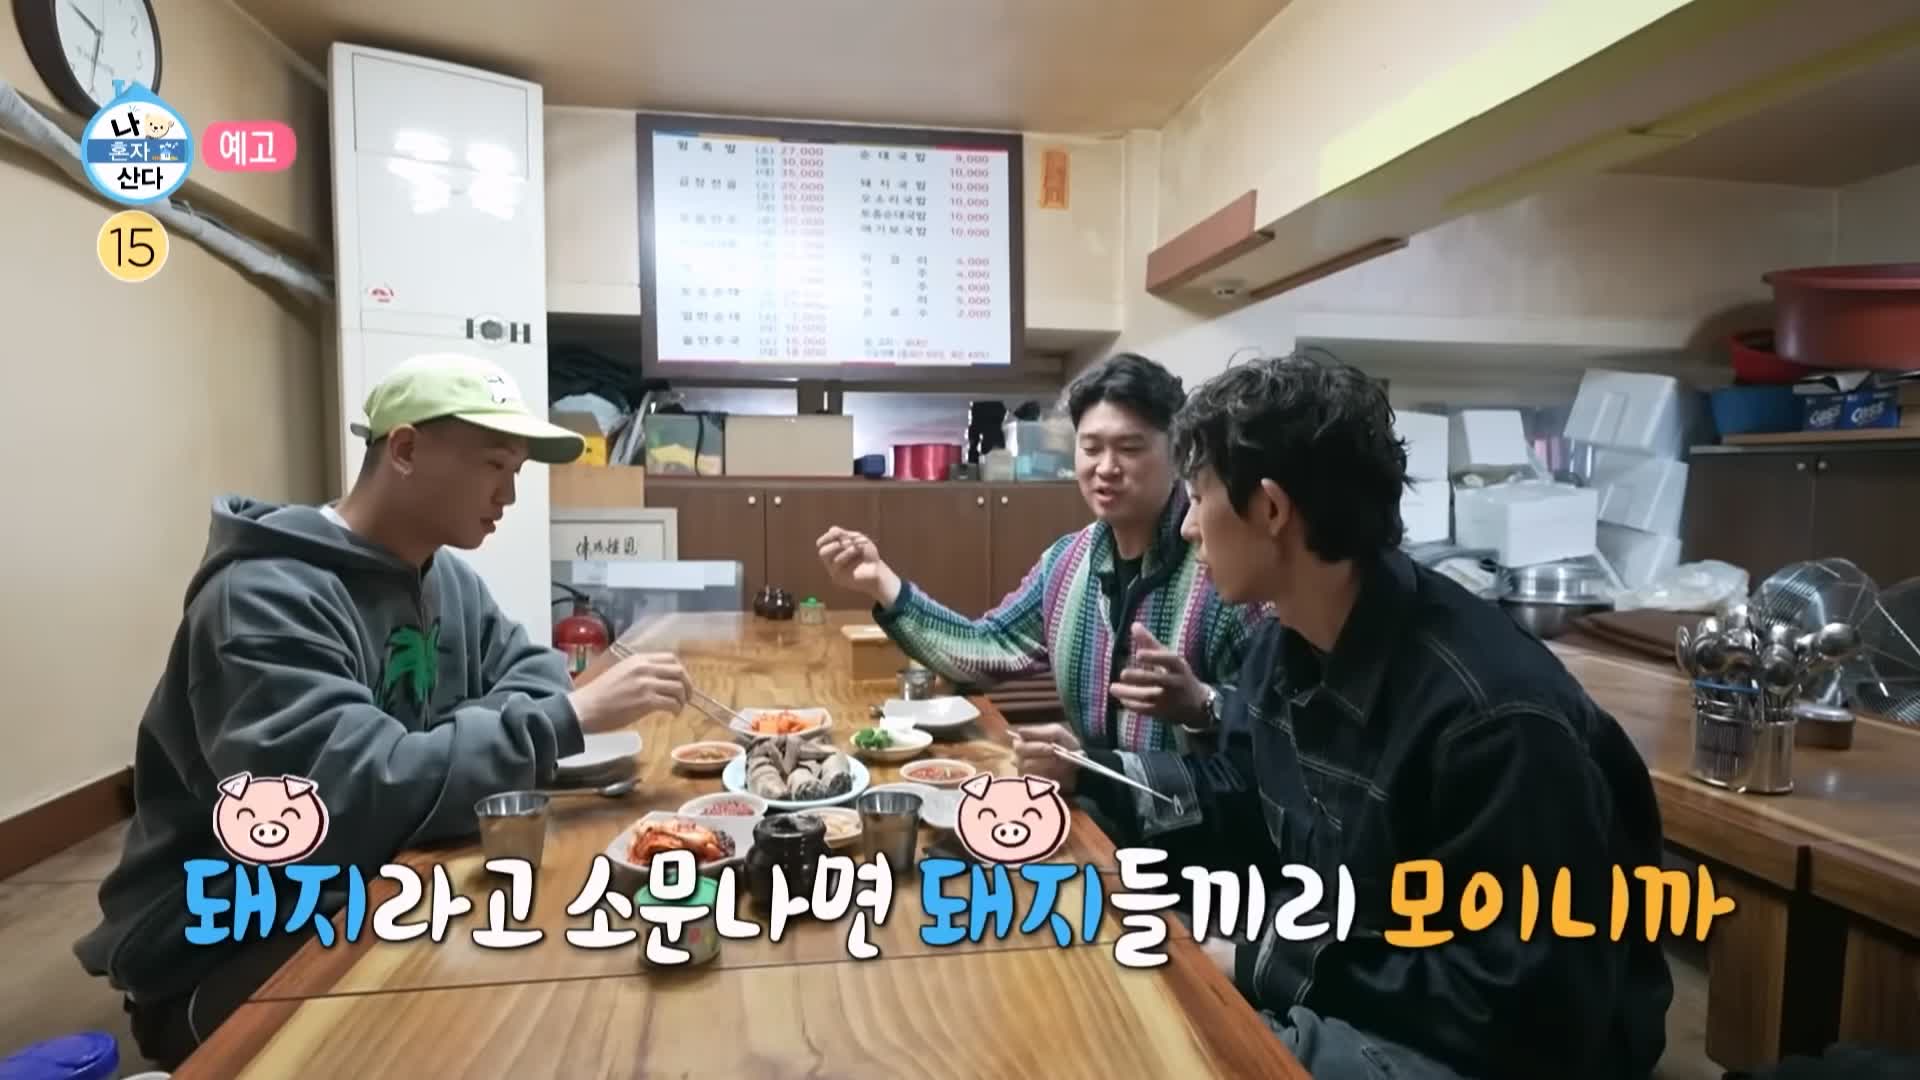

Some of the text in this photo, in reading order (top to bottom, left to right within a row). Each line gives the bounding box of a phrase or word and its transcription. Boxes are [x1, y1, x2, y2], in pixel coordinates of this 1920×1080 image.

[950, 167, 989, 178] 10,000
[951, 181, 989, 193] 10,000
[951, 196, 989, 208] 10,000
[951, 210, 990, 222] 10,000
